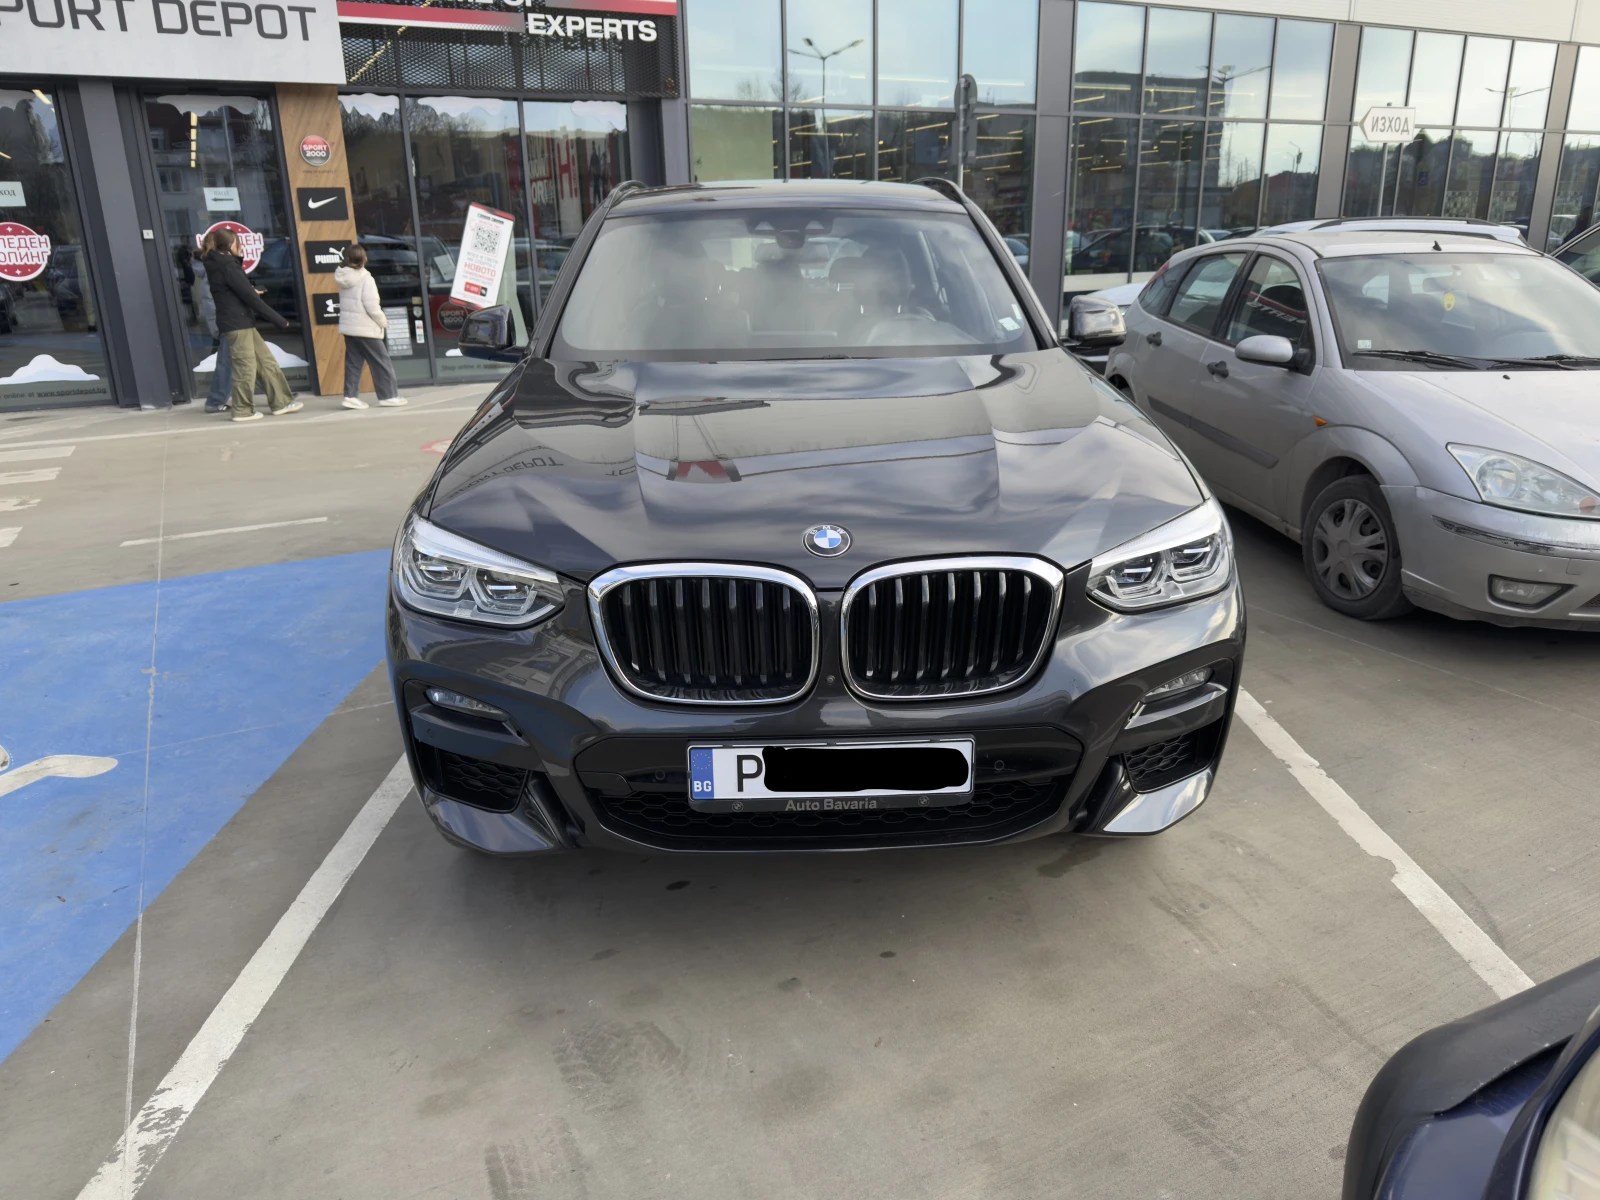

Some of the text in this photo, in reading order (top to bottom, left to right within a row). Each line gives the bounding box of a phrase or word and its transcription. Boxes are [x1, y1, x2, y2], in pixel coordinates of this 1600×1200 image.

[154, 0, 316, 41] DEPOT
[527, 13, 658, 41] EXPERTS
[1371, 116, 1409, 135] ИЗХОД
[464, 262, 497, 277] НОВОТО
[37, 386, 107, 397] www.sportdepot.bg
[736, 754, 763, 792] P
[693, 780, 712, 792] BG
[784, 797, 877, 811] Auto Bavaria
